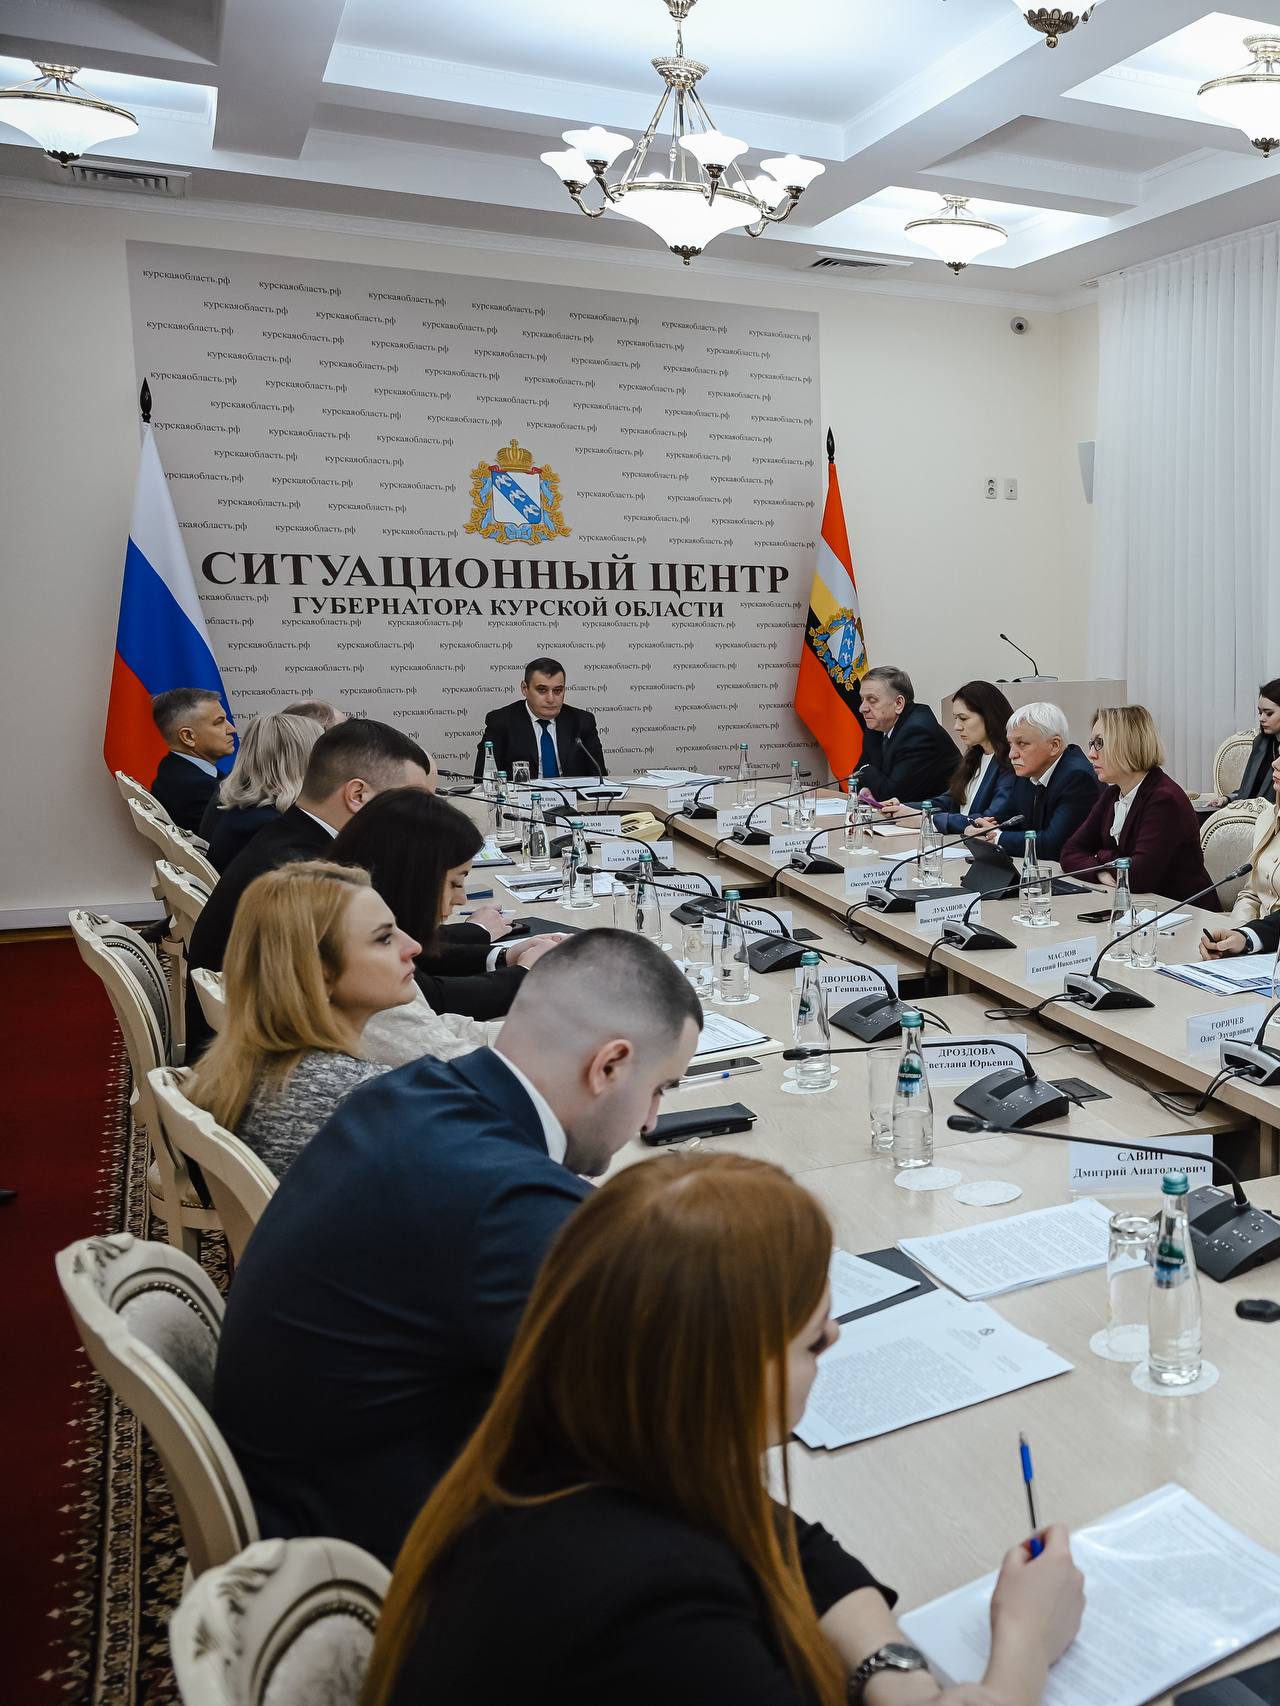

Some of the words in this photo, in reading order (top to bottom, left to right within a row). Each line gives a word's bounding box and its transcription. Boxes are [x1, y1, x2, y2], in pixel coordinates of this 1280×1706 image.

[142, 270, 231, 286] курскаяобласть.рф
[258, 281, 342, 297] курскаяобласть.рф
[368, 292, 447, 308] курскаяобласть.рф
[203, 301, 289, 316] курскаяобласть.рф
[471, 302, 546, 317] курскаяобласть.рф
[315, 311, 397, 326] курскаяобласть.рф
[569, 312, 640, 326] курскаяобласть.рф
[144, 321, 234, 336] курскаяобласть.рф
[422, 321, 498, 336] курскаяобласть.рф
[661, 321, 728, 335] курскаяобласть.рф
[262, 330, 345, 345] курскаяобласть.рф
[522, 330, 594, 344] курскаяобласть.рф
[370, 340, 449, 355] курскаяобласть.рф
[616, 339, 685, 353] курскаяобласть.рф
[207, 351, 292, 366] курскаяобласть.рф
[473, 349, 548, 363] курскаяобласть.рф
[318, 359, 399, 374] курскаяобласть.рф
[571, 357, 641, 371] курскаяобласть.рф
[150, 370, 238, 386] курскаяобласть.рф
[424, 368, 501, 382] курскаяобласть.рф
[663, 365, 729, 378] курскаяобласть.рф
[265, 379, 348, 393] курскаяобласть.рф
[524, 376, 596, 389] курскаяобласть.рф
[373, 387, 452, 401] курскаяобласть.рф
[618, 383, 687, 396] курскаяобласть.рф
[210, 400, 295, 414] курскаяобласть.рф
[476, 395, 550, 408] курскаяобласть.рф
[321, 408, 402, 421] курскаяобласть.рф
[573, 402, 643, 415] курскаяобласть.рф
[664, 408, 731, 421] курскаяобласть.рф
[153, 420, 241, 435] курскаяобласть.рф
[427, 415, 503, 427] курскаяобласть.рф
[526, 419, 598, 433] курскаяобласть.рф
[268, 428, 351, 441] курскаяобласть.рф
[620, 427, 688, 439] курскаяобласть.рф
[376, 435, 454, 447] курскаяобласть.рф
[213, 449, 298, 462] курскаяобласть.рф
[574, 446, 644, 458] курскаяобласть.рф
[665, 452, 732, 463] курскаяобласть.рф
[324, 455, 405, 468] курскаяобласть.рф
[163, 471, 245, 484] урскаяобласть.рф
[271, 476, 354, 489] курскаяобласть.рф
[621, 471, 689, 482] курскаяобласть.рф
[379, 480, 457, 493] курскаяобласть.рф
[576, 490, 646, 501] курскаяобласть.рф
[667, 494, 733, 505] курскаяобласть.рф
[217, 498, 301, 510] курскаяобласть.рф
[327, 502, 407, 515] курскаяобласть.рф
[623, 514, 691, 525] курскаяобласть.рф
[275, 524, 357, 536] курскаяобласть.рф
[381, 526, 459, 538] курскаяобласть.рф
[578, 534, 648, 544] курскаяобласть.рф
[668, 536, 734, 547] курскаяобласть.рф
[201, 551, 638, 595] СИТУАЦИОННЫЙ
[649, 563, 790, 599] ЦЕНТР
[292, 596, 483, 616] ГУБЕРНАТОРА
[491, 596, 607, 617] КУРСКОЙ
[615, 601, 725, 618] ОБЛАСТИ
[739, 600, 802, 611] курскаяобласть.рф
[281, 617, 362, 628] курскаяобласть.рф
[387, 618, 464, 629] курскаяобласть.рф
[487, 619, 560, 629] курскаяобласть.рф
[582, 619, 651, 629] курскаяобласть.рф
[227, 640, 311, 651] курскаяобласть.рф
[336, 640, 415, 651] курскаяобласть.рф
[439, 640, 513, 651] курскаяобласть.рф
[536, 640, 607, 651] курскаяобласть.рф
[628, 641, 695, 651] курскаяобласть.рф
[284, 663, 365, 674] курскаяобласть.рф
[390, 663, 466, 673] курскаяобласть.рф
[583, 661, 652, 672] курскаяобласть.рф
[672, 661, 738, 671] курскаяобласть.рф
[231, 686, 314, 698] курскаяобласть.рф
[339, 685, 418, 696] курскаяобласть.рф
[441, 684, 516, 696] курскаяобласть.рф
[716, 681, 779, 691] курскаяобласть.рф
[392, 707, 469, 719] курскаяобласть.рф
[585, 704, 653, 714] курскаяобласть.рф
[717, 721, 780, 732] курскаяобласть.рф
[675, 743, 740, 753] курскаяобласть.рф
[1047, 949, 1077, 961] МАСЛОВ
[820, 974, 873, 984] ДВОРЦОВА
[1211, 1016, 1245, 1030] ГОРЯЧЕВ
[1200, 1035, 1216, 1043] Олег
[938, 1047, 996, 1057] ДРОЗДОВА
[969, 1059, 1014, 1069] Юрьевна
[1072, 1166, 1128, 1180] Дмитрий
[1130, 1164, 1207, 1177] Анатольевич
